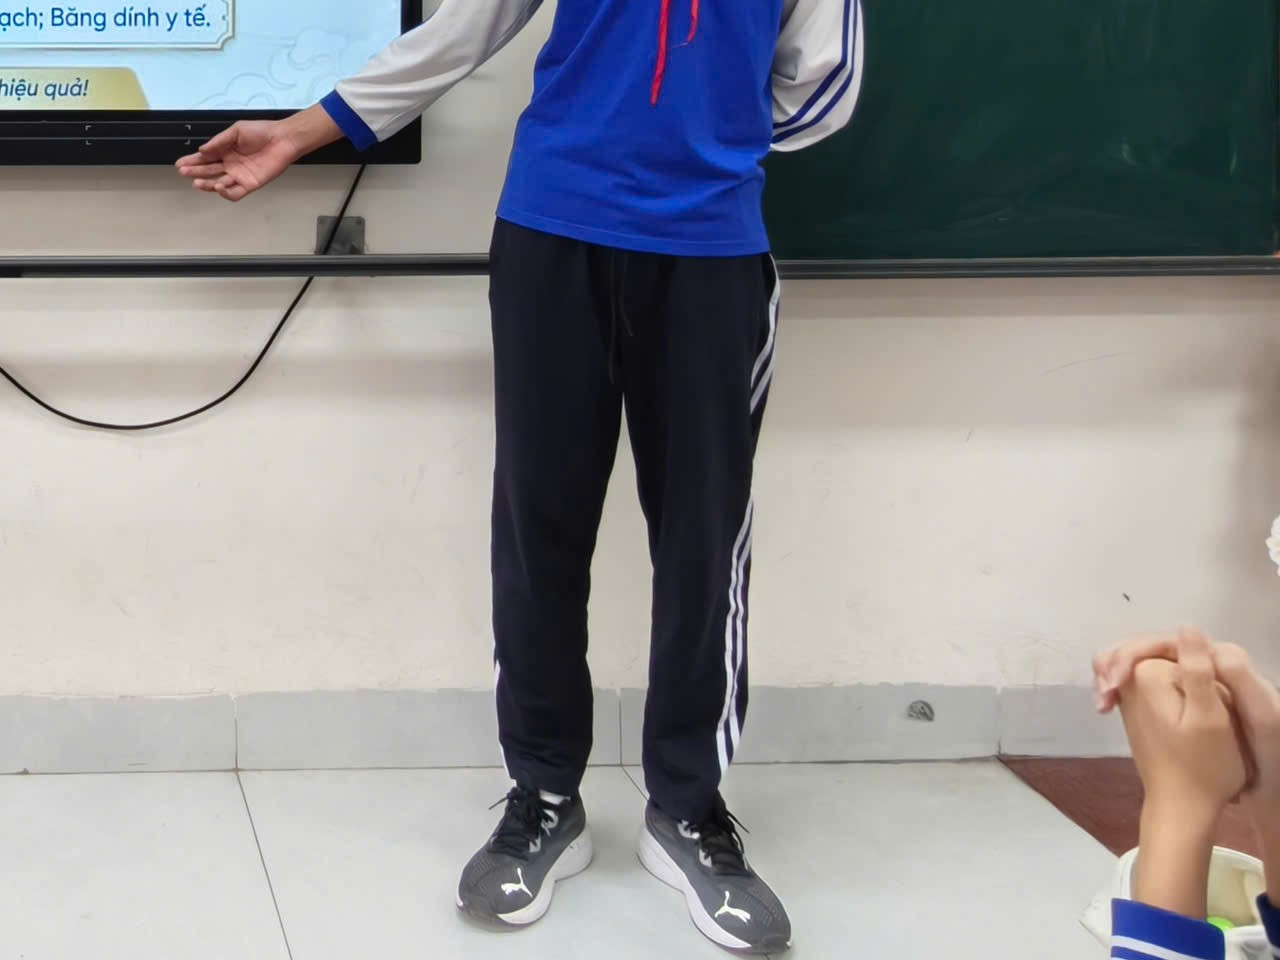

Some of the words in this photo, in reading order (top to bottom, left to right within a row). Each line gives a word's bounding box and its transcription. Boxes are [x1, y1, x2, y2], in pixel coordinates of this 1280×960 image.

[51, 7, 107, 32] Băng
[113, 6, 159, 27] dính
[165, 12, 178, 32] y
[183, 3, 211, 27] tế.
[44, 77, 89, 101] quả!
